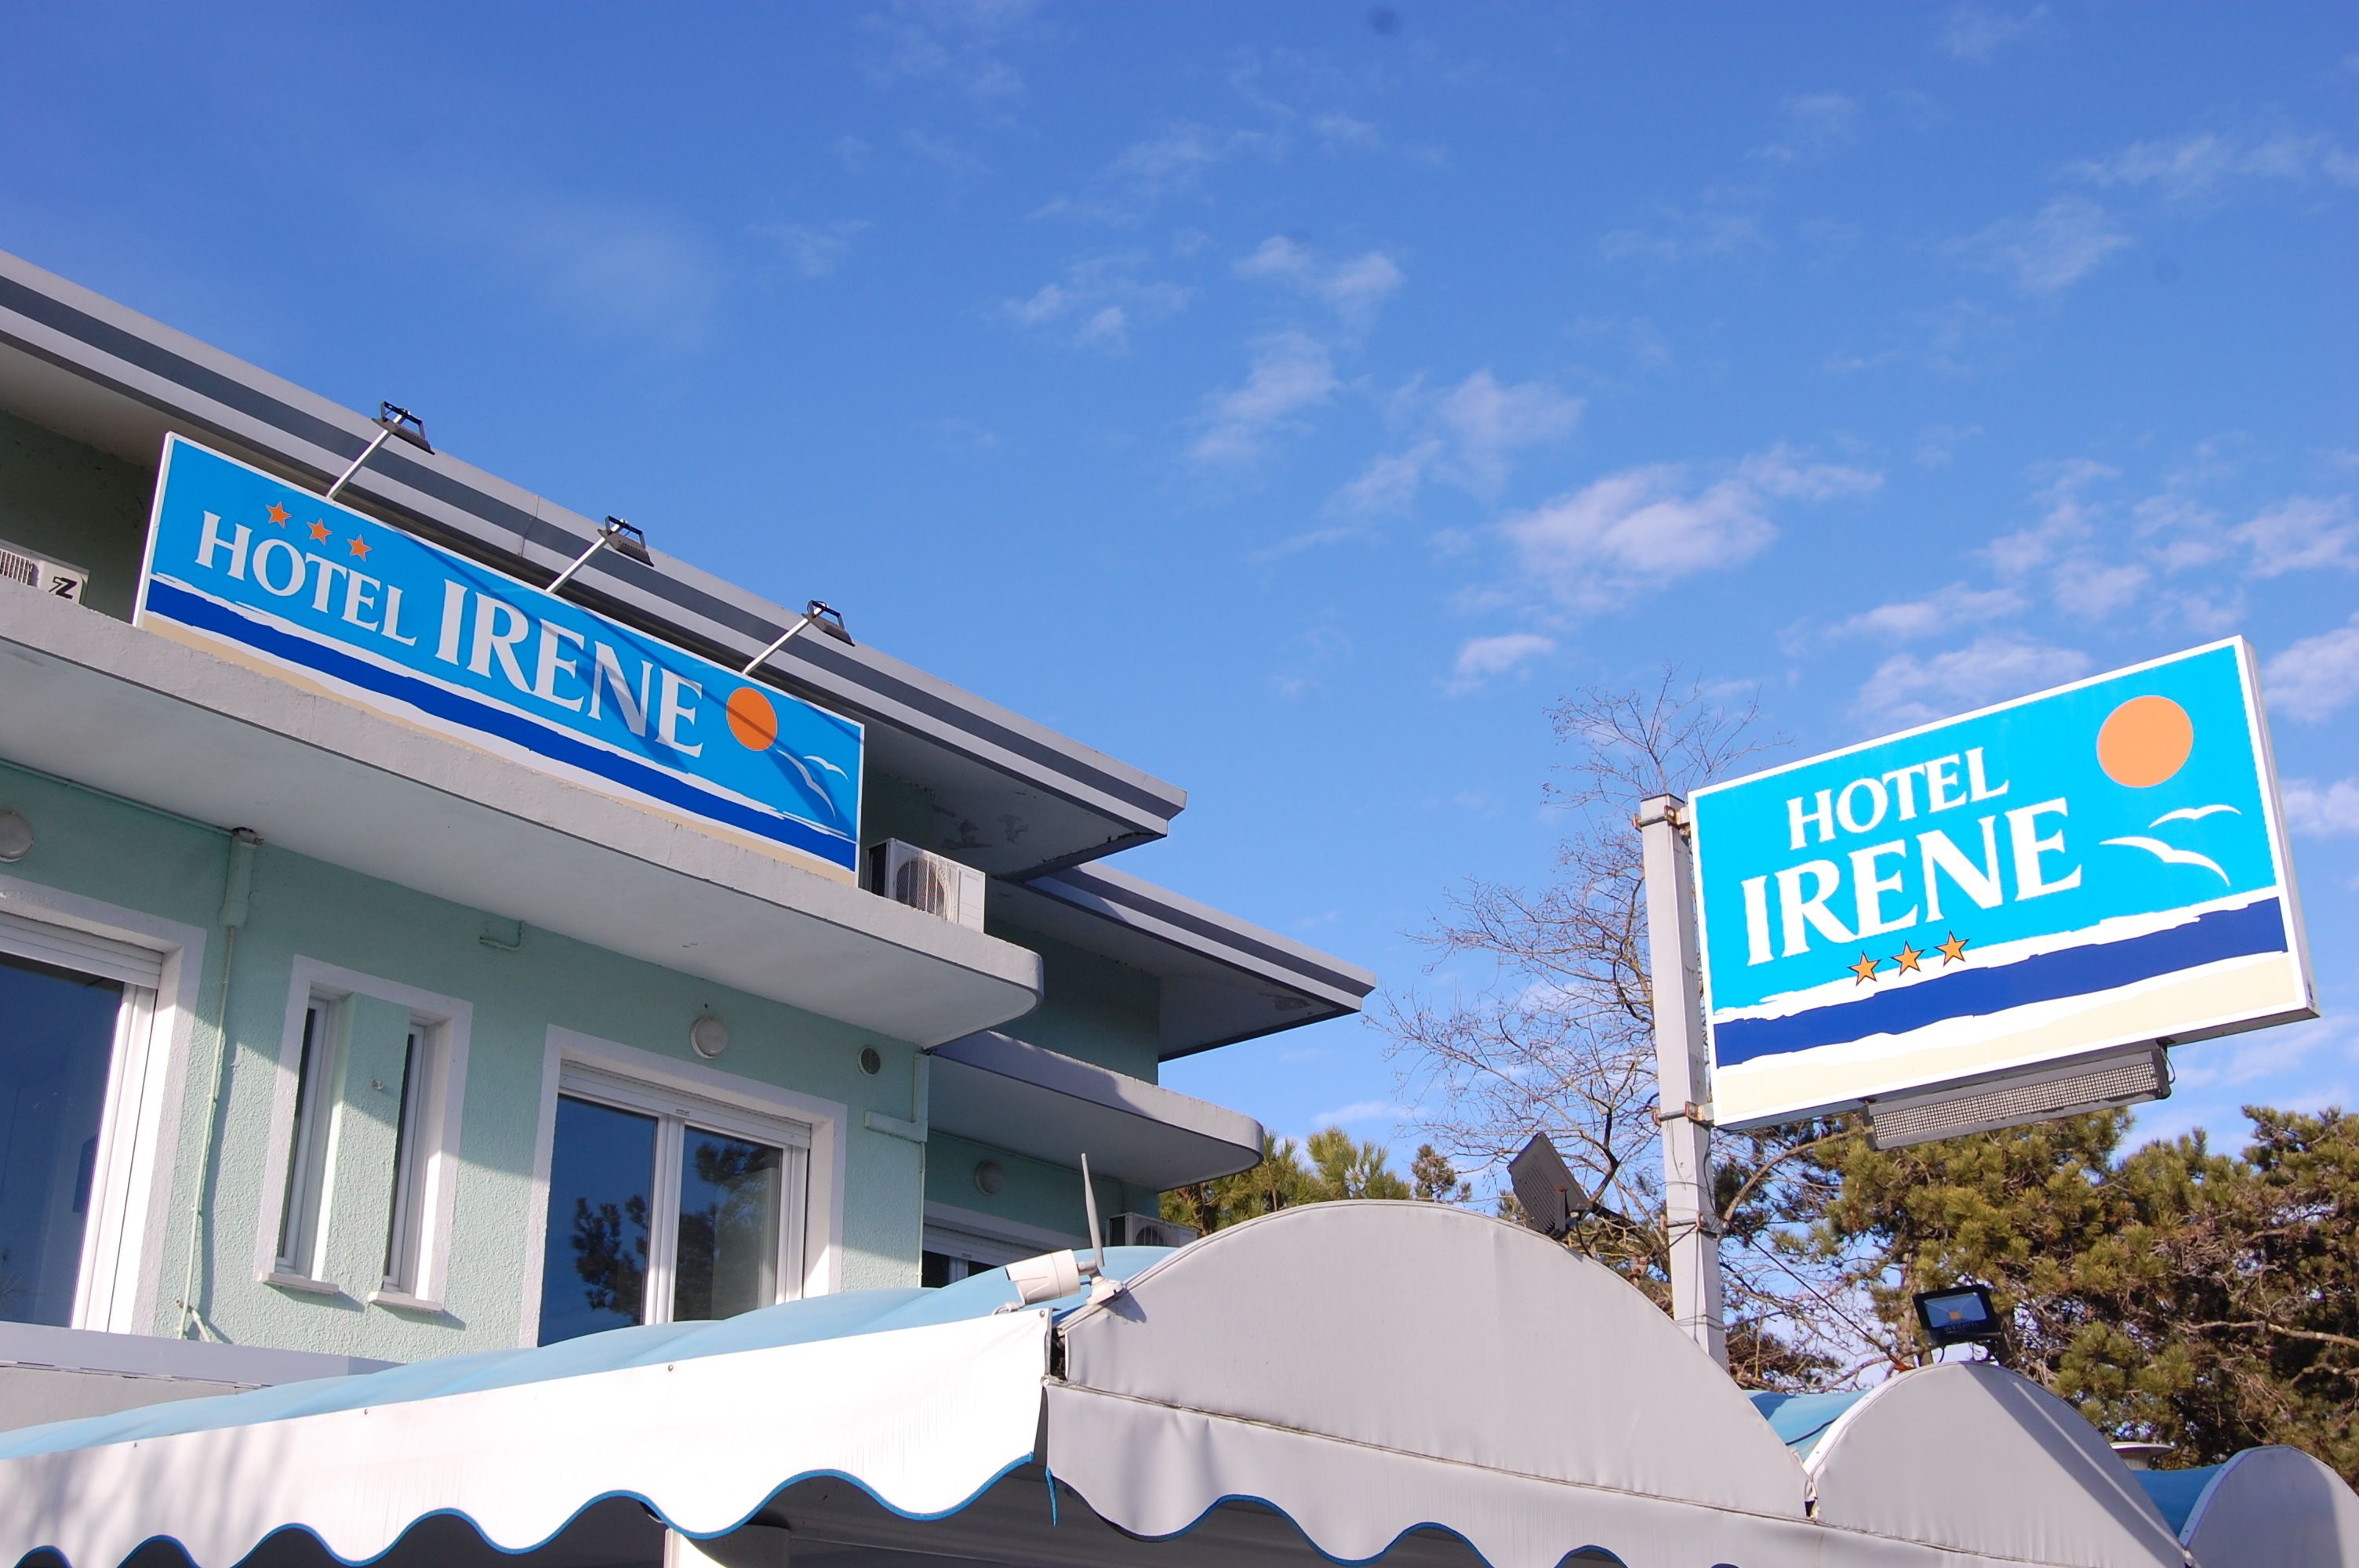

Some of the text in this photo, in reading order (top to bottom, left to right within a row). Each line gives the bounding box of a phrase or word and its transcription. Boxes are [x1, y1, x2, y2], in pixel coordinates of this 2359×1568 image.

[194, 510, 703, 758] HOTEL IRENE
[1741, 797, 2081, 966] IRENE
[1787, 746, 2009, 851] HOTEL
